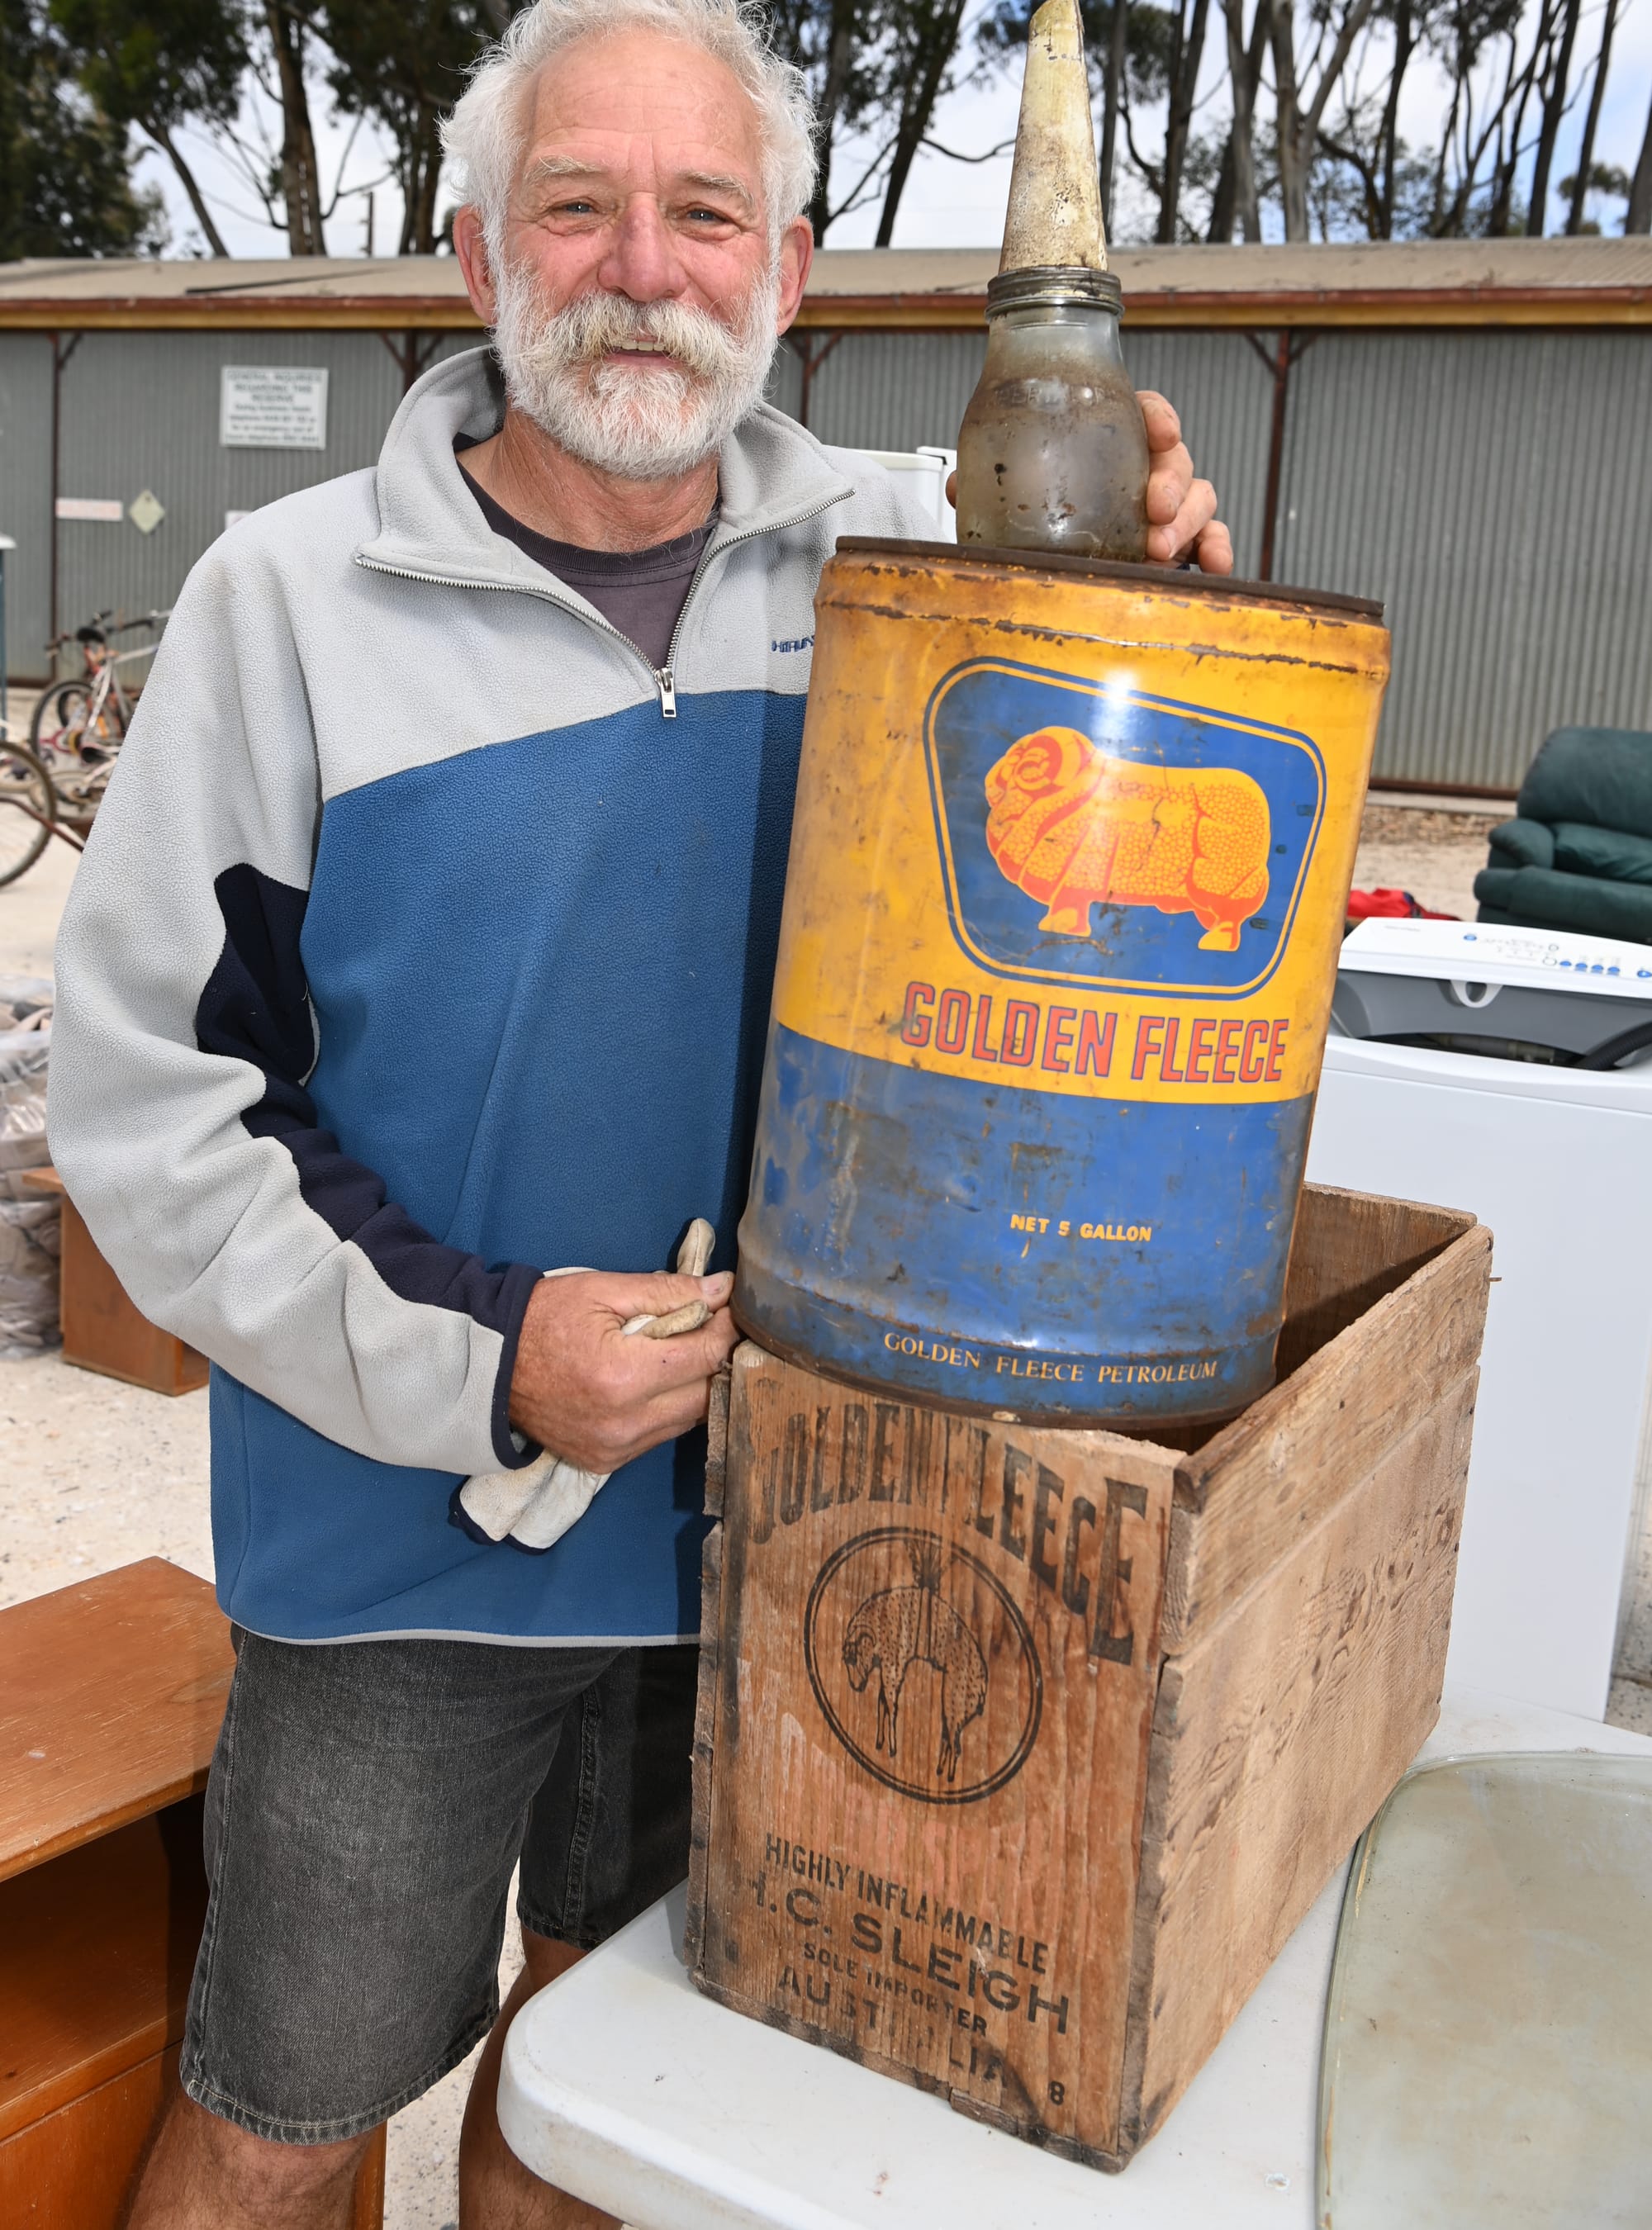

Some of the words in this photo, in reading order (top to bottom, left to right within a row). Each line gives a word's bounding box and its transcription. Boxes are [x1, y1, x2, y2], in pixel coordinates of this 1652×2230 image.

[900, 980, 1118, 1078] GOLDEN
[1131, 1015, 1289, 1084] FLEECE
[1010, 1213, 1050, 1234] NET
[1058, 1220, 1070, 1236] 5
[1080, 1222, 1152, 1242] GALLON
[884, 1331, 981, 1369] GOLDEN
[995, 1355, 1085, 1383] FLEECE
[1098, 1360, 1219, 1384] PETROLEUM
[766, 1831, 851, 1891] HIGHLY
[858, 1869, 1049, 1975] INFLAMMABLE
[804, 1942, 858, 1980] SOLE
[866, 1967, 988, 2037] IMPORTER
[852, 1912, 1070, 2035] SLEIGH
[778, 1965, 1006, 2090] AUSTALIA
[1048, 2081, 1066, 2106] 8
